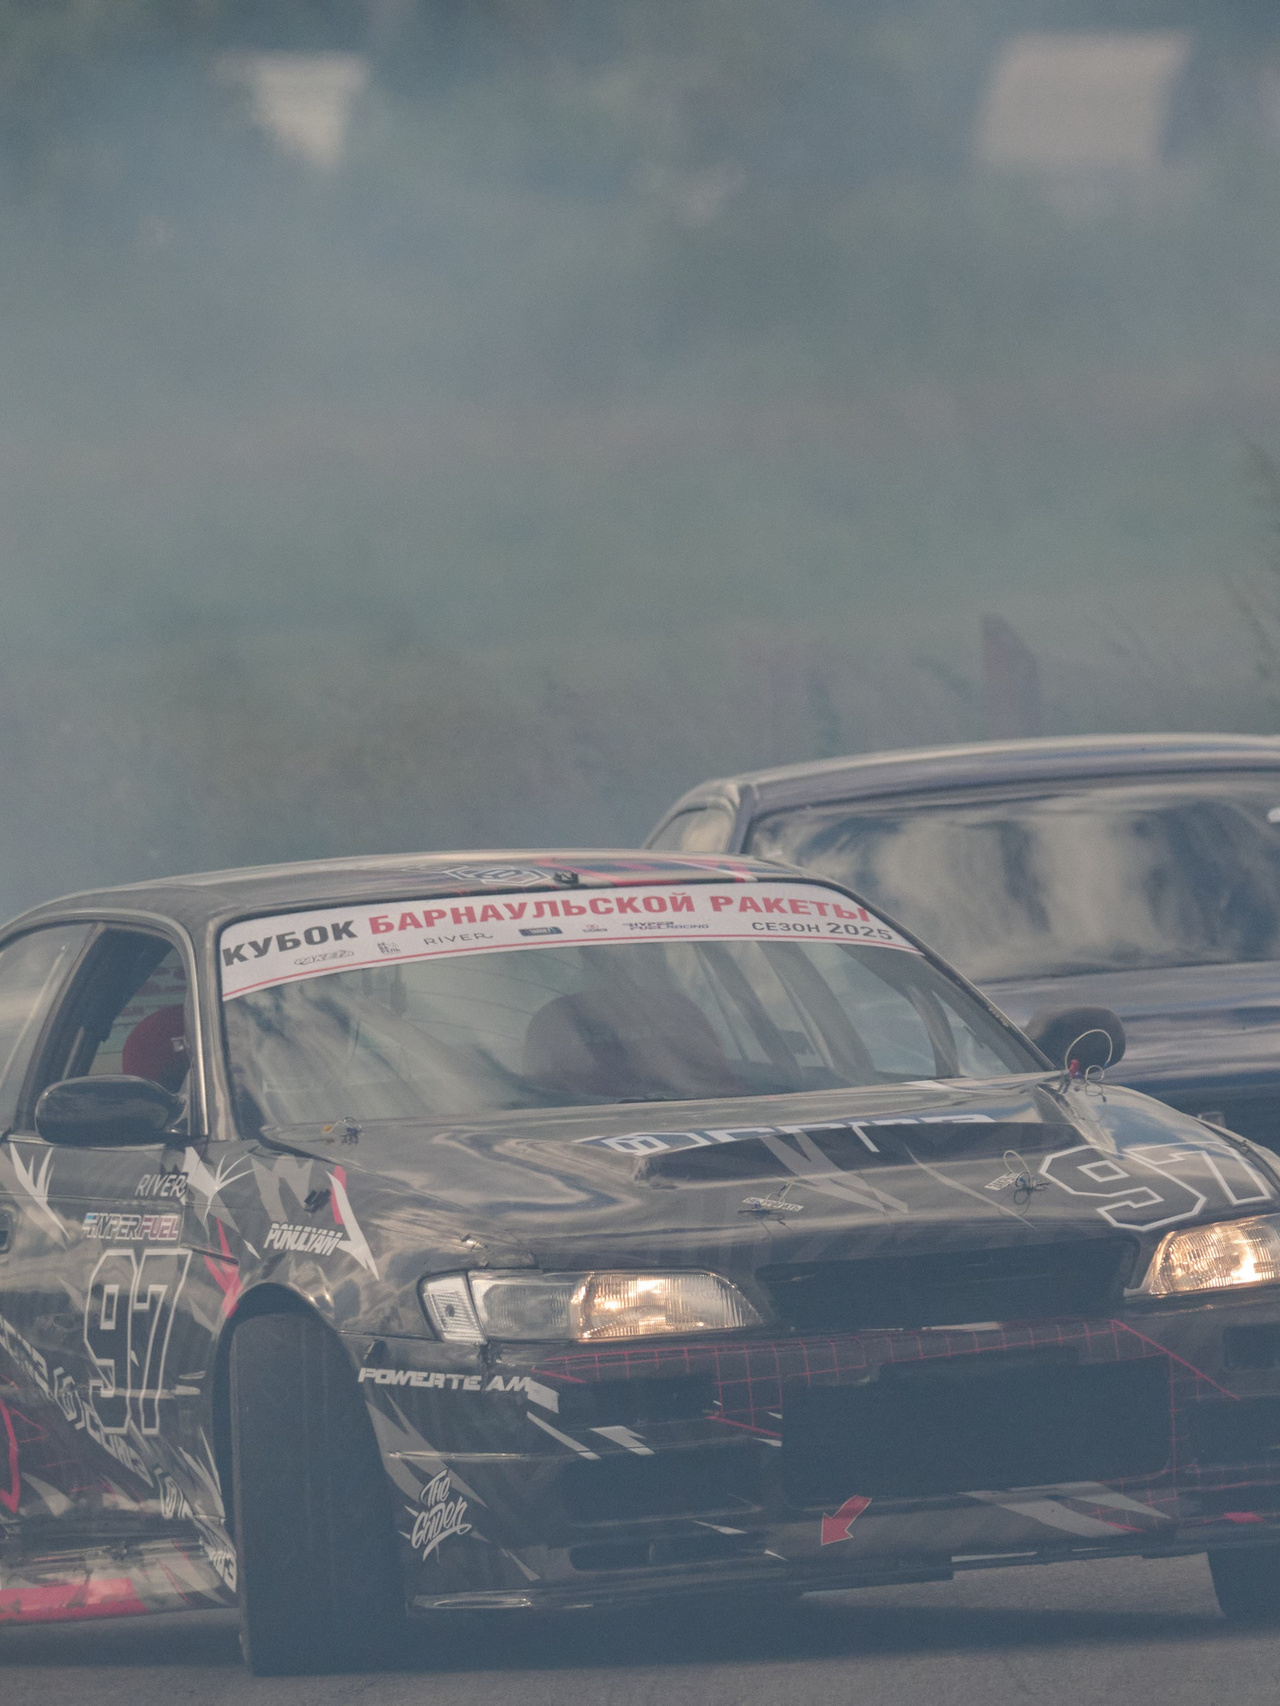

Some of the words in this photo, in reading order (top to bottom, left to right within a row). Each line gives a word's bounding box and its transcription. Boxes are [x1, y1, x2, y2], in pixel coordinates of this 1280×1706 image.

[223, 920, 357, 967] КУБОК
[368, 892, 694, 935] БАРНАУЛЬСКОЙ
[710, 895, 871, 923] РАКЕТЫ
[423, 931, 494, 946] RIVER
[751, 921, 821, 934] СЕЗОН
[828, 922, 893, 941] 2025
[1038, 1142, 1272, 1232] 97
[84, 1248, 193, 1434] 97
